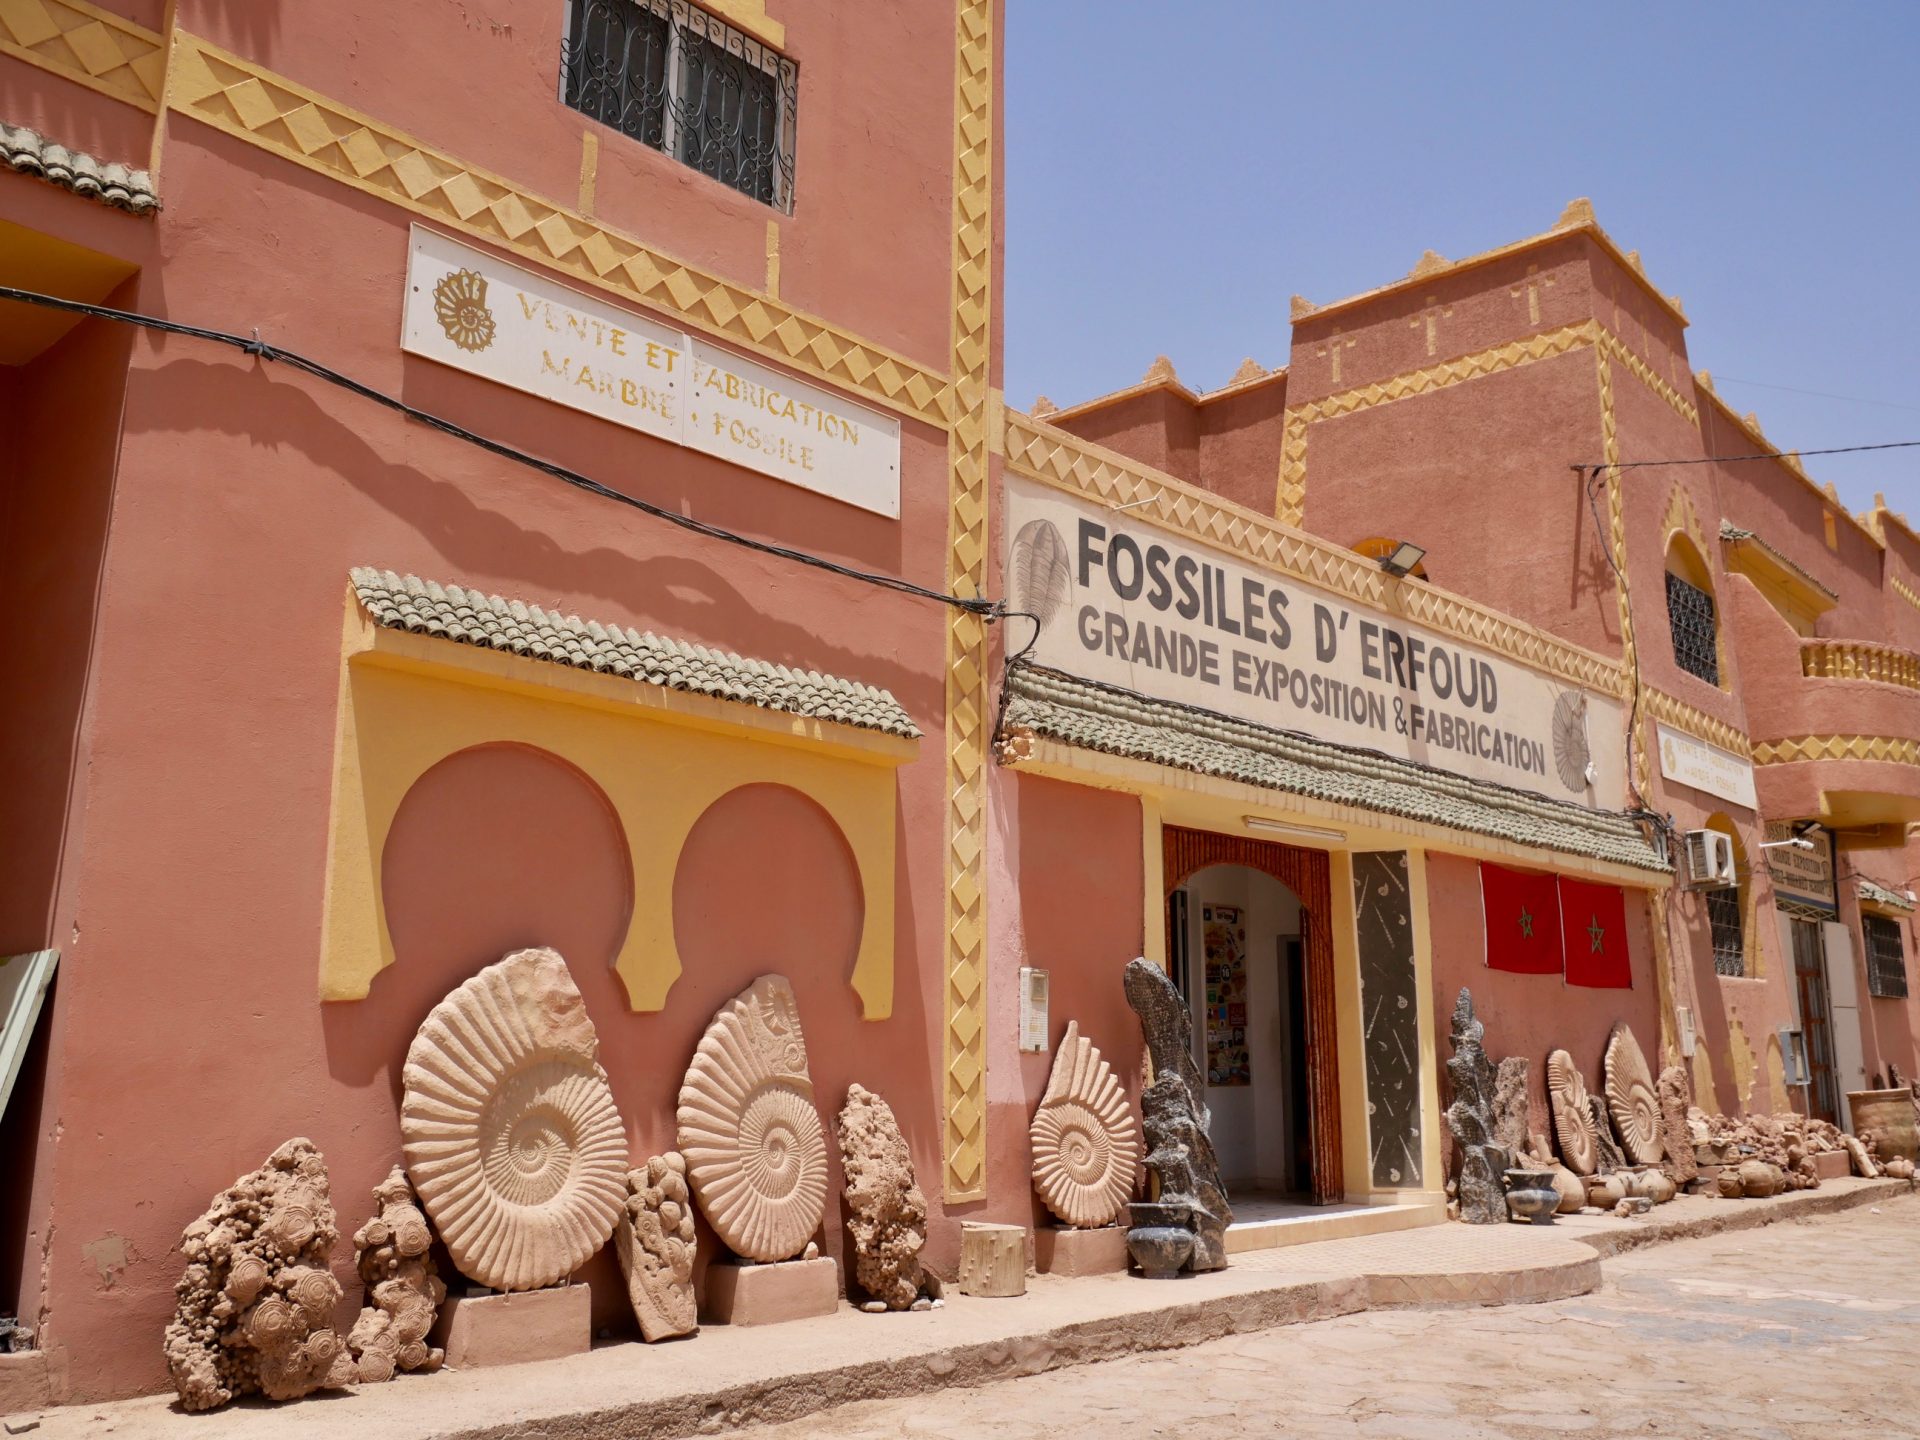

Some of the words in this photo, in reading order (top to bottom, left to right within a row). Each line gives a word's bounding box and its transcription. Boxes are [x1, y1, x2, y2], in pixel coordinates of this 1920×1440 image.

[516, 292, 627, 356] VENTE
[645, 342, 680, 373] ET
[693, 358, 859, 446] FABRICATION
[541, 349, 676, 419] MARBRE
[713, 411, 814, 471] FOSSILE
[1078, 517, 1291, 650] FOSSILES
[1078, 604, 1220, 686] GRANDE
[1232, 649, 1387, 731] EXPOSITION
[1393, 696, 1408, 736] &
[1410, 703, 1545, 776] FABRICATION
